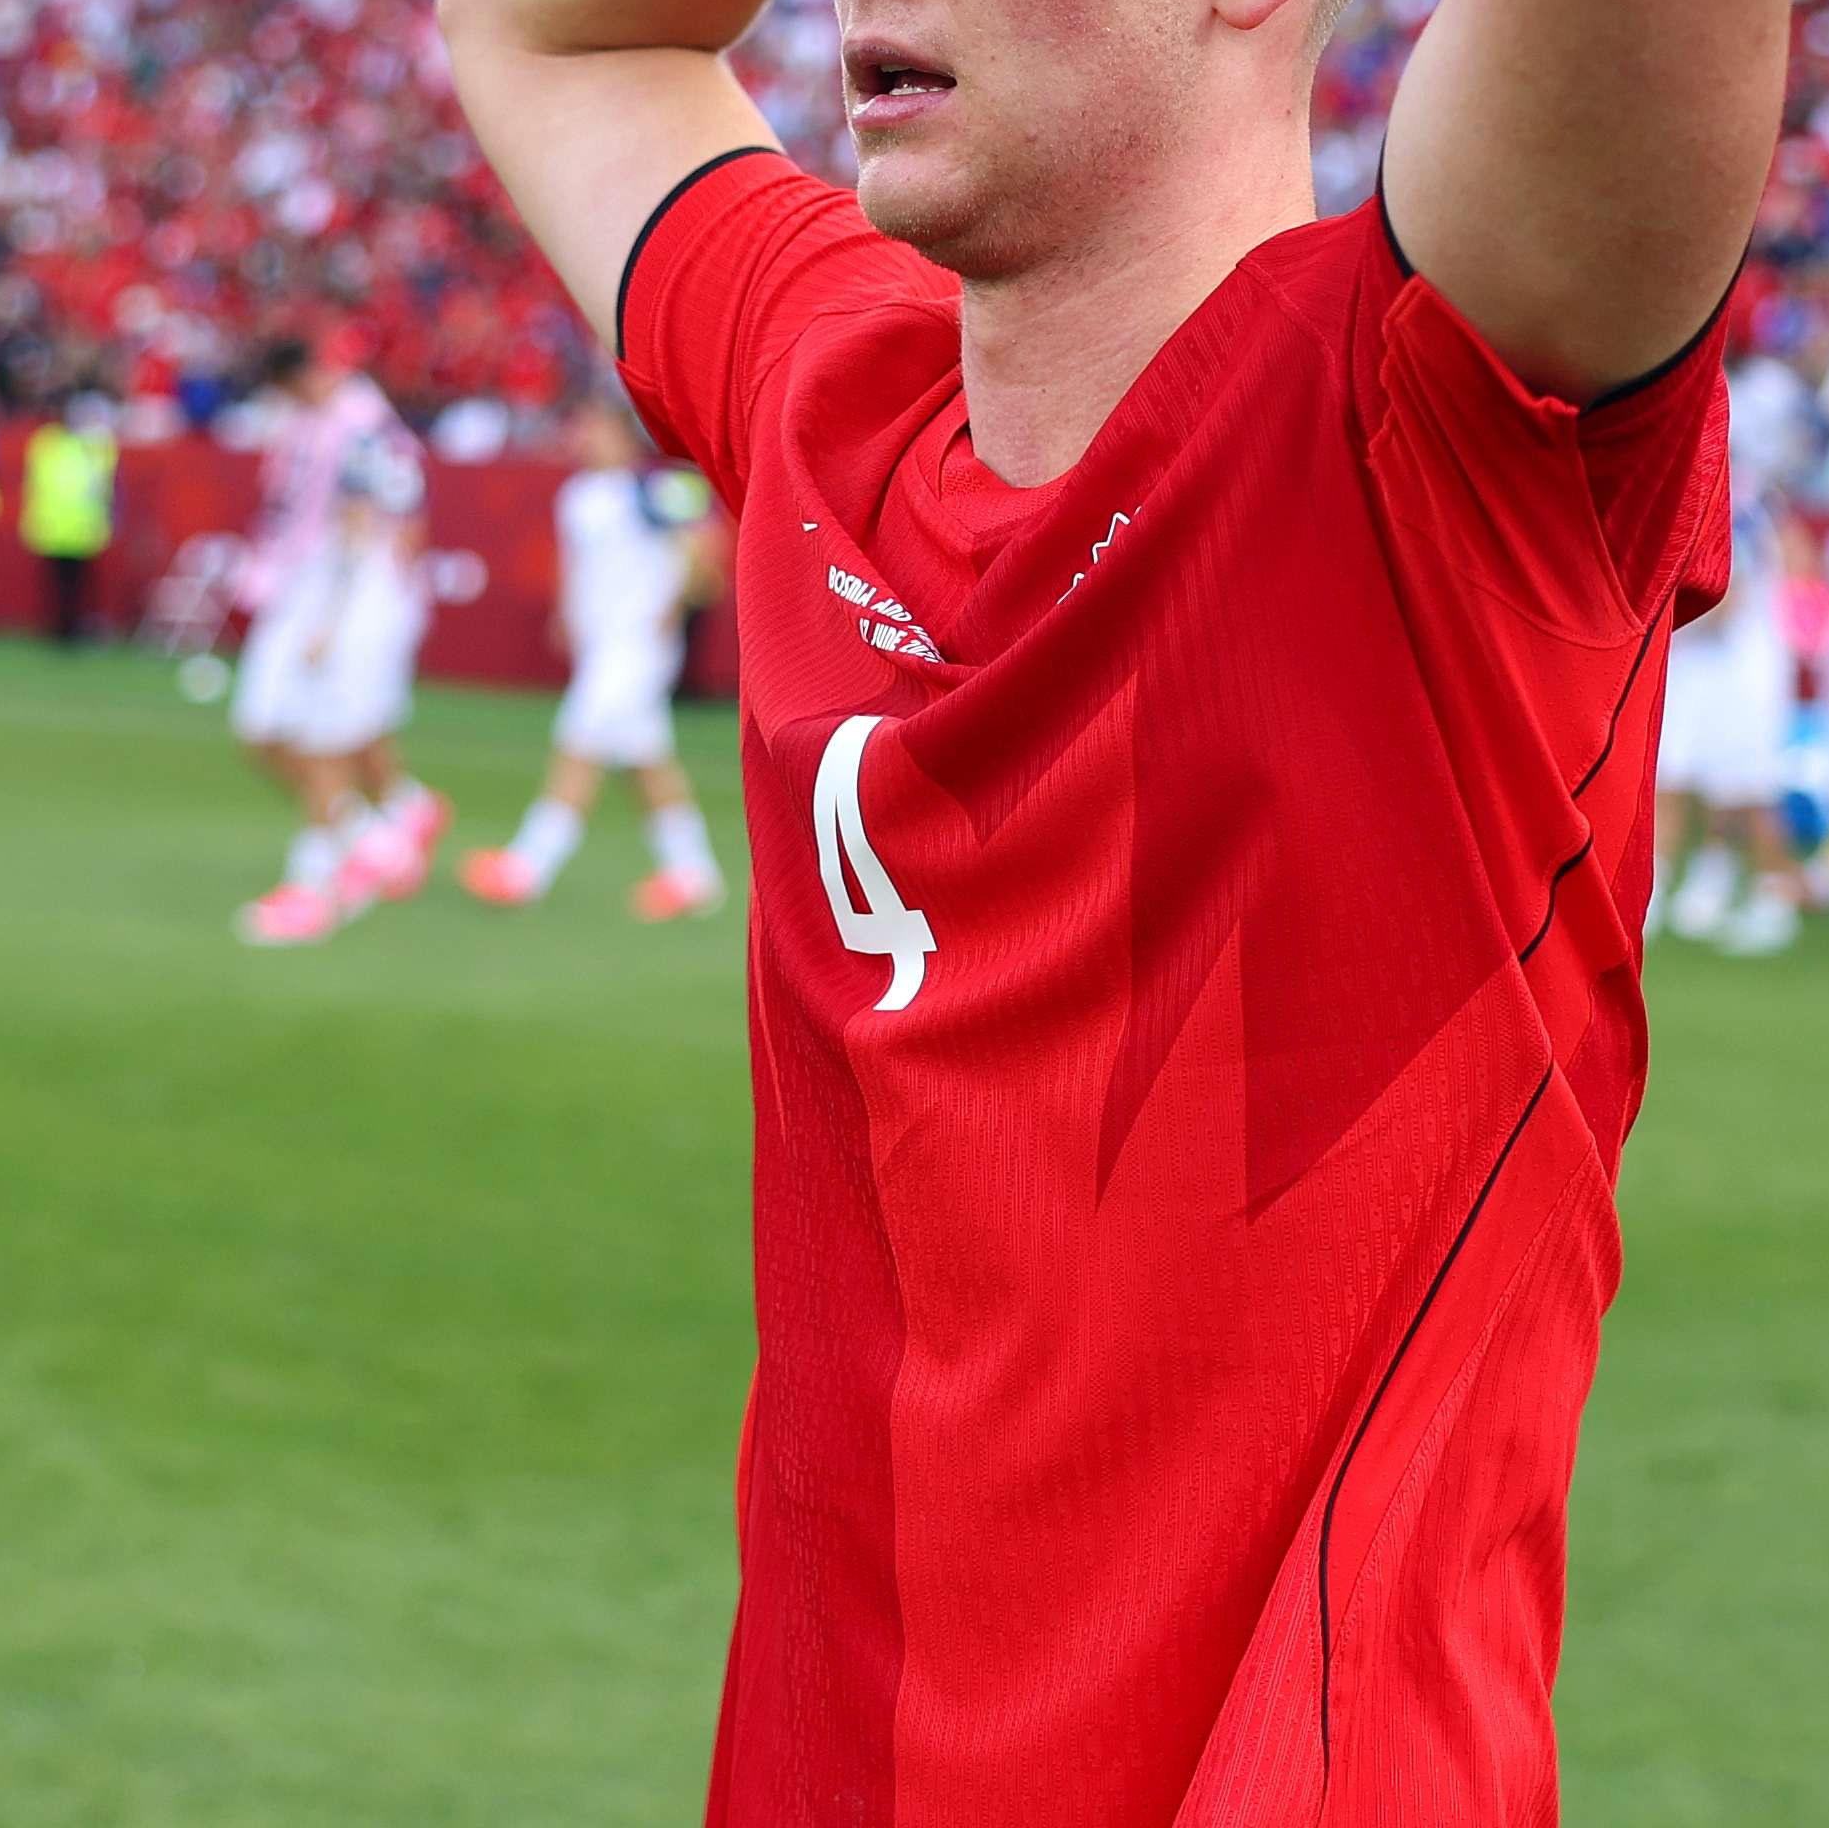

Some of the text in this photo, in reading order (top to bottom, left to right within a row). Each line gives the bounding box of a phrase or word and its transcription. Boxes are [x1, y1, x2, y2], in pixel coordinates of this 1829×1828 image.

[828, 565, 913, 622] BOSNIA AND
[871, 623, 908, 652] JUNE
[813, 715, 937, 1011] 4
